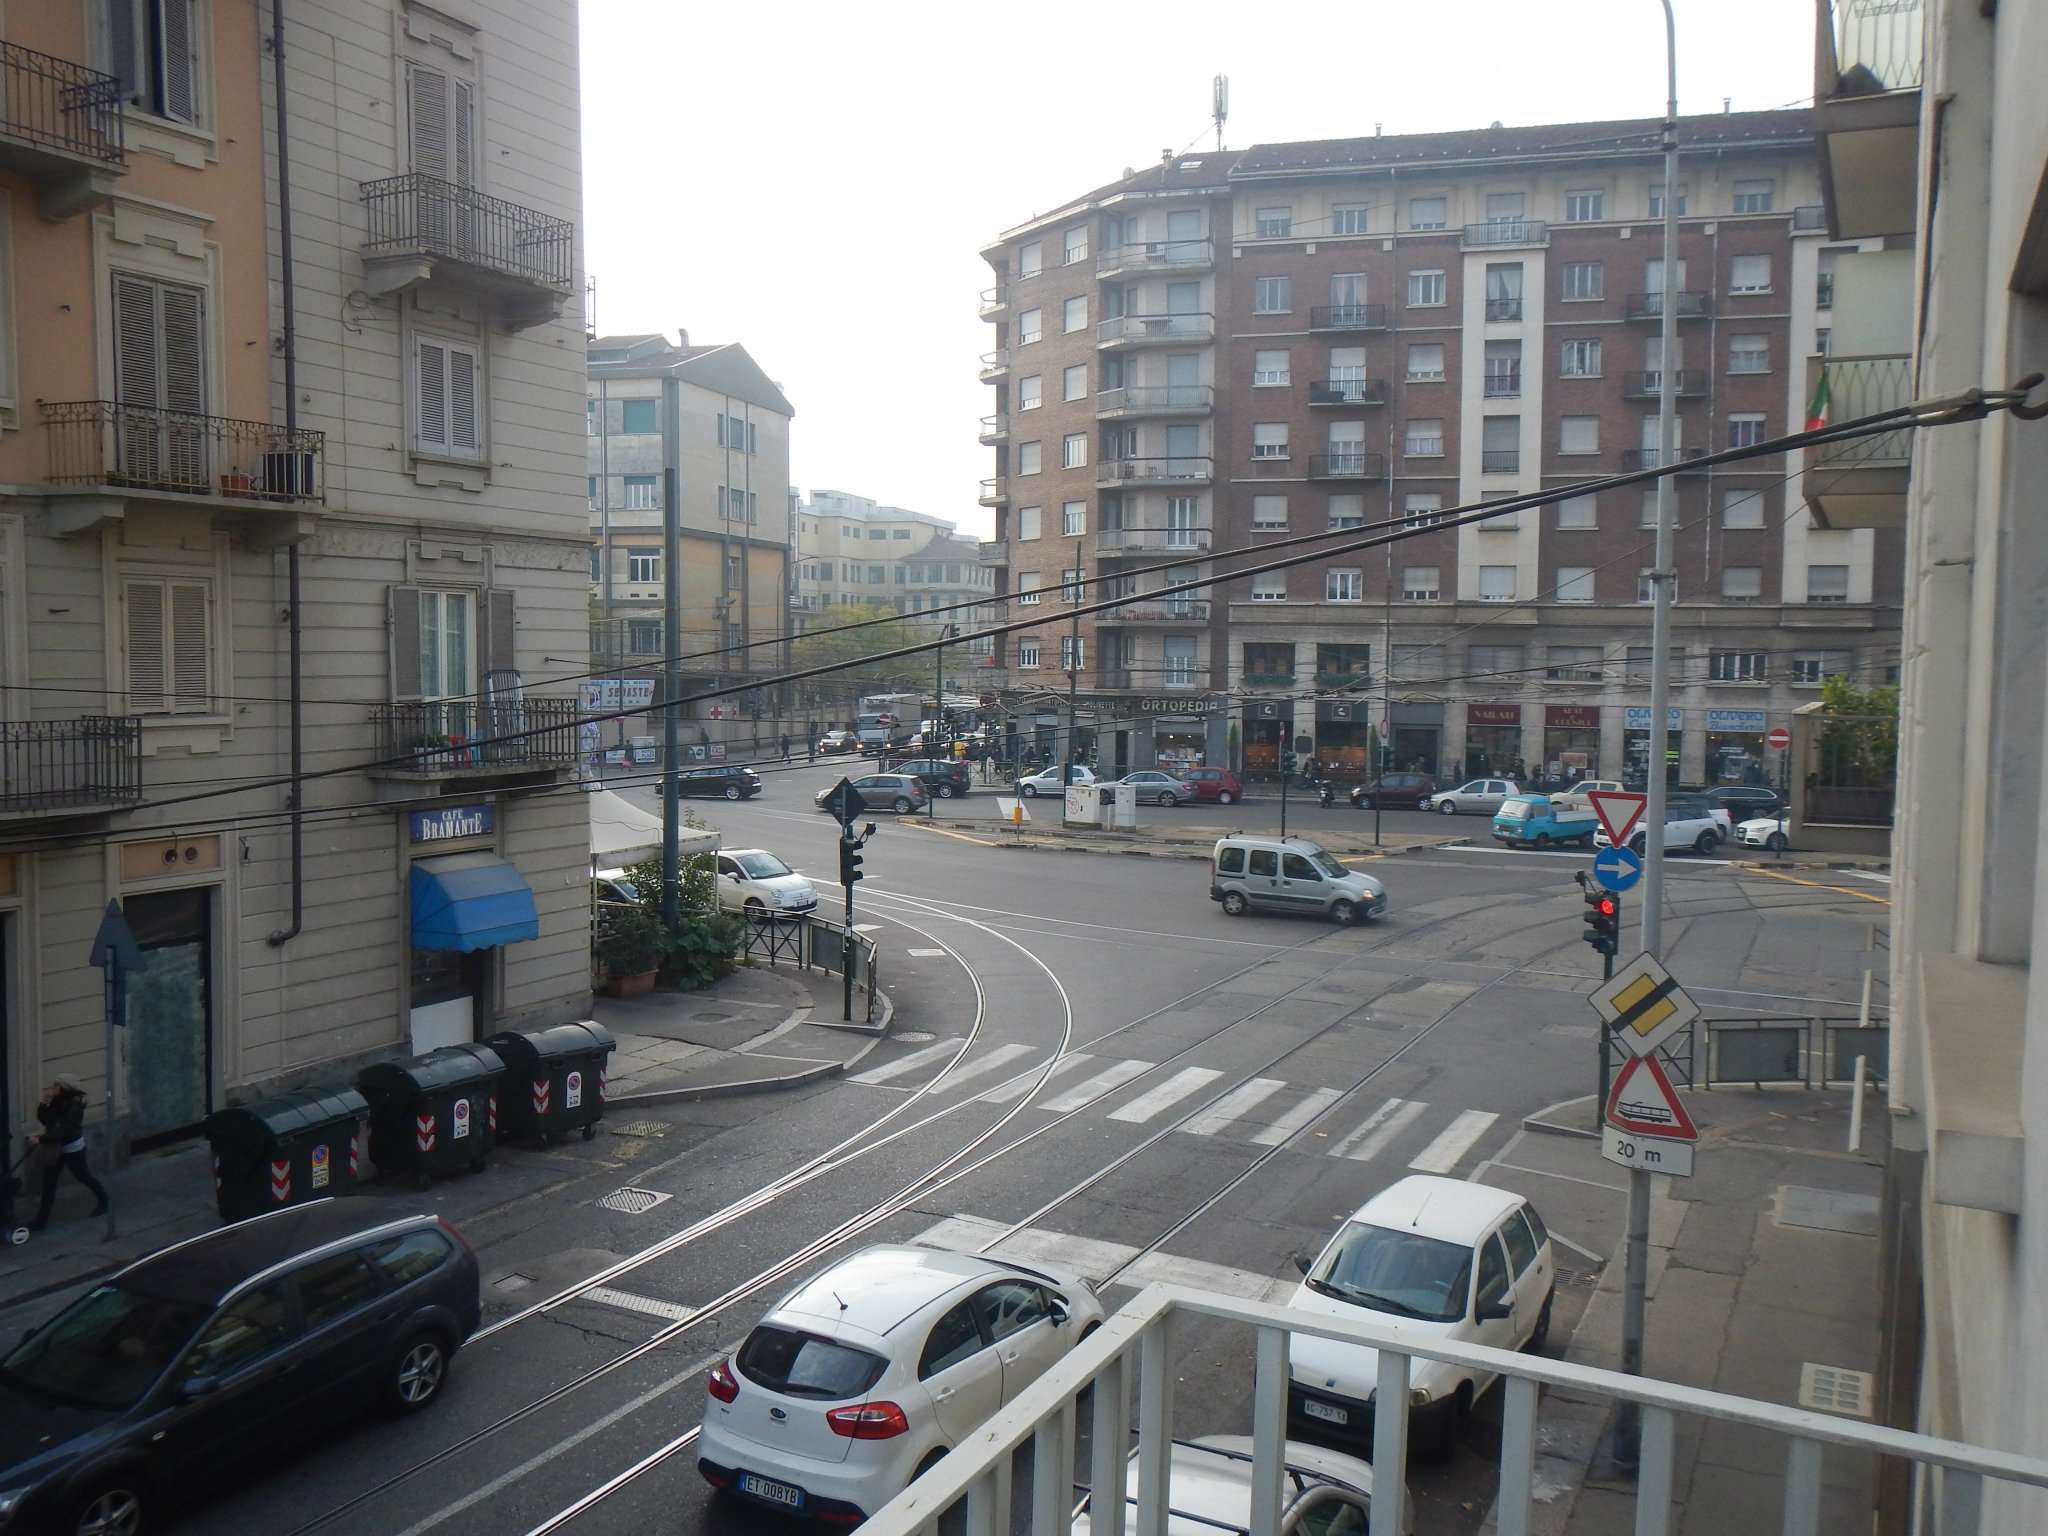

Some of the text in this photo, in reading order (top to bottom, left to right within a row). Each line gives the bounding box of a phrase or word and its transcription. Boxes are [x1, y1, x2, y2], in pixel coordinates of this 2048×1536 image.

[1142, 700, 1217, 712] ORTOPEDIA
[422, 813, 482, 840] BRAMANTE
[1617, 1141, 1661, 1162] 20 m
